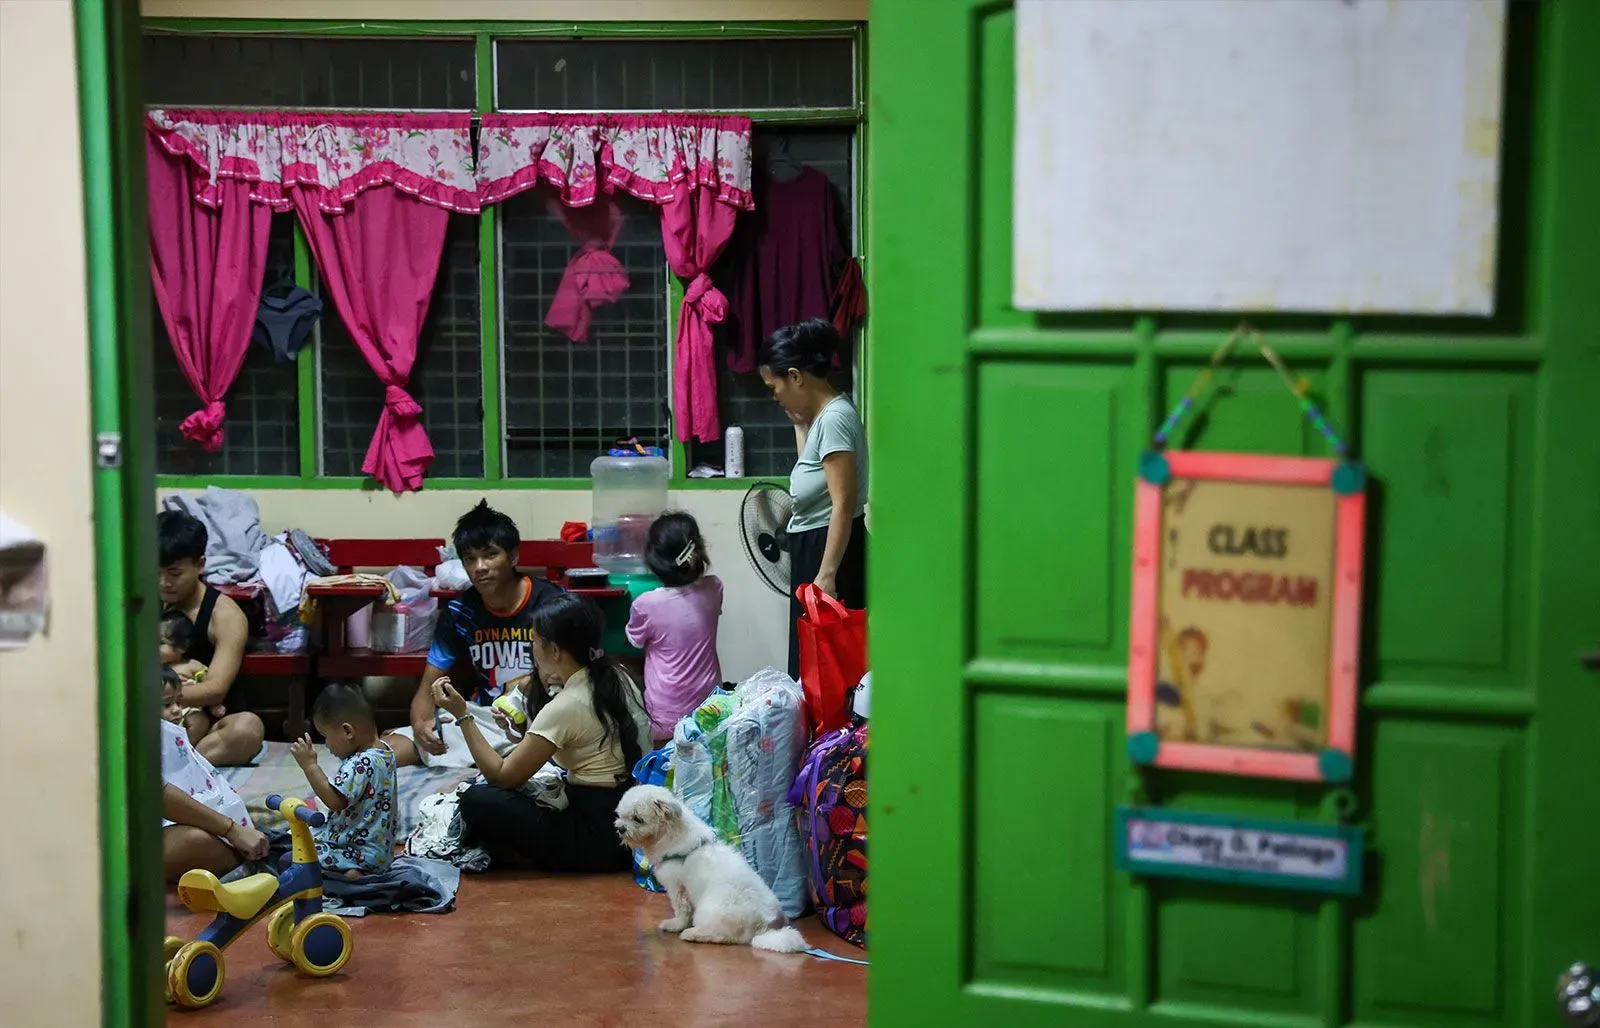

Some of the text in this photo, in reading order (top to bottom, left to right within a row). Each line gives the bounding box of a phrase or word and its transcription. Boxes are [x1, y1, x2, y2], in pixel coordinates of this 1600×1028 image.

[1207, 524, 1288, 559] CLASS
[1182, 569, 1318, 607] PROGRAM
[469, 640, 536, 669] POWE
